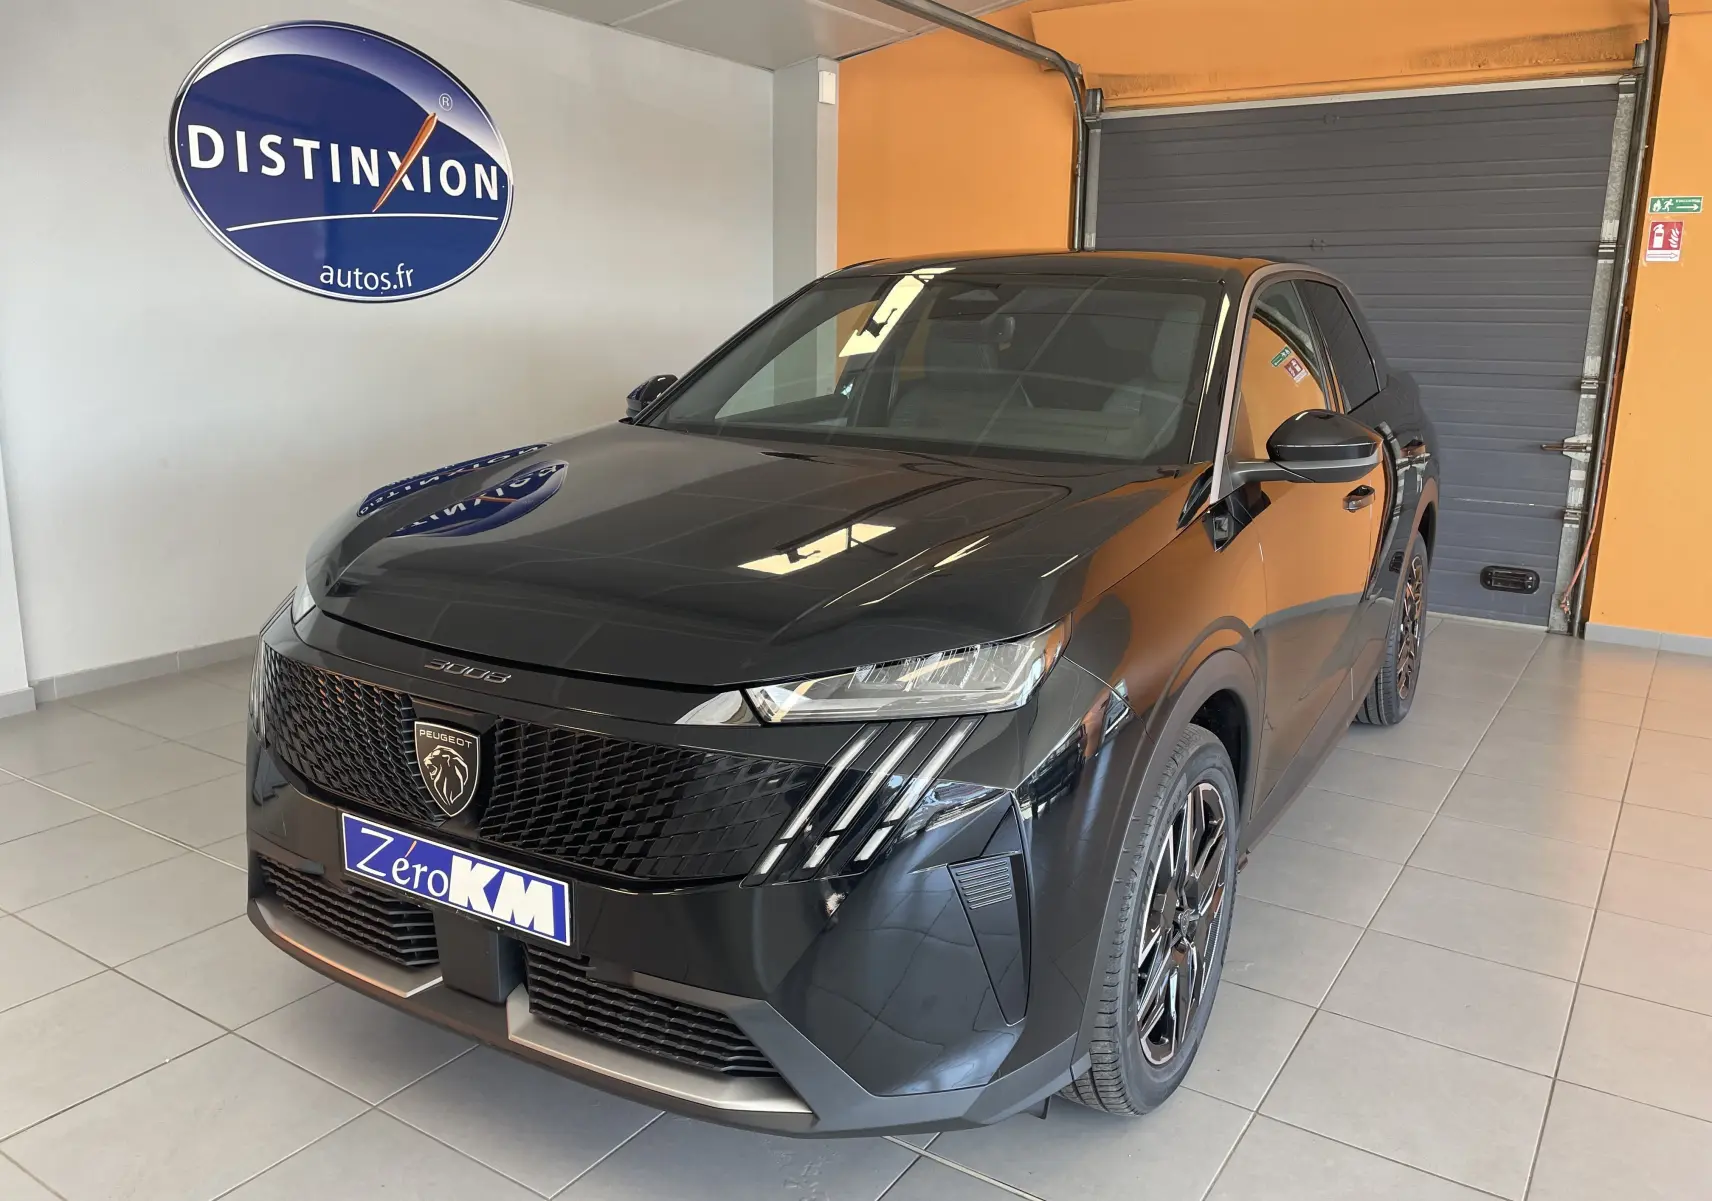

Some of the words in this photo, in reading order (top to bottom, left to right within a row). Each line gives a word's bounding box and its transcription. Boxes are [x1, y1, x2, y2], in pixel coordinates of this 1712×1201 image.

[187, 112, 498, 212] DISTINXION
[319, 263, 414, 290] autos.fr
[424, 658, 512, 684] 3008
[419, 729, 473, 749] PEUGEOT
